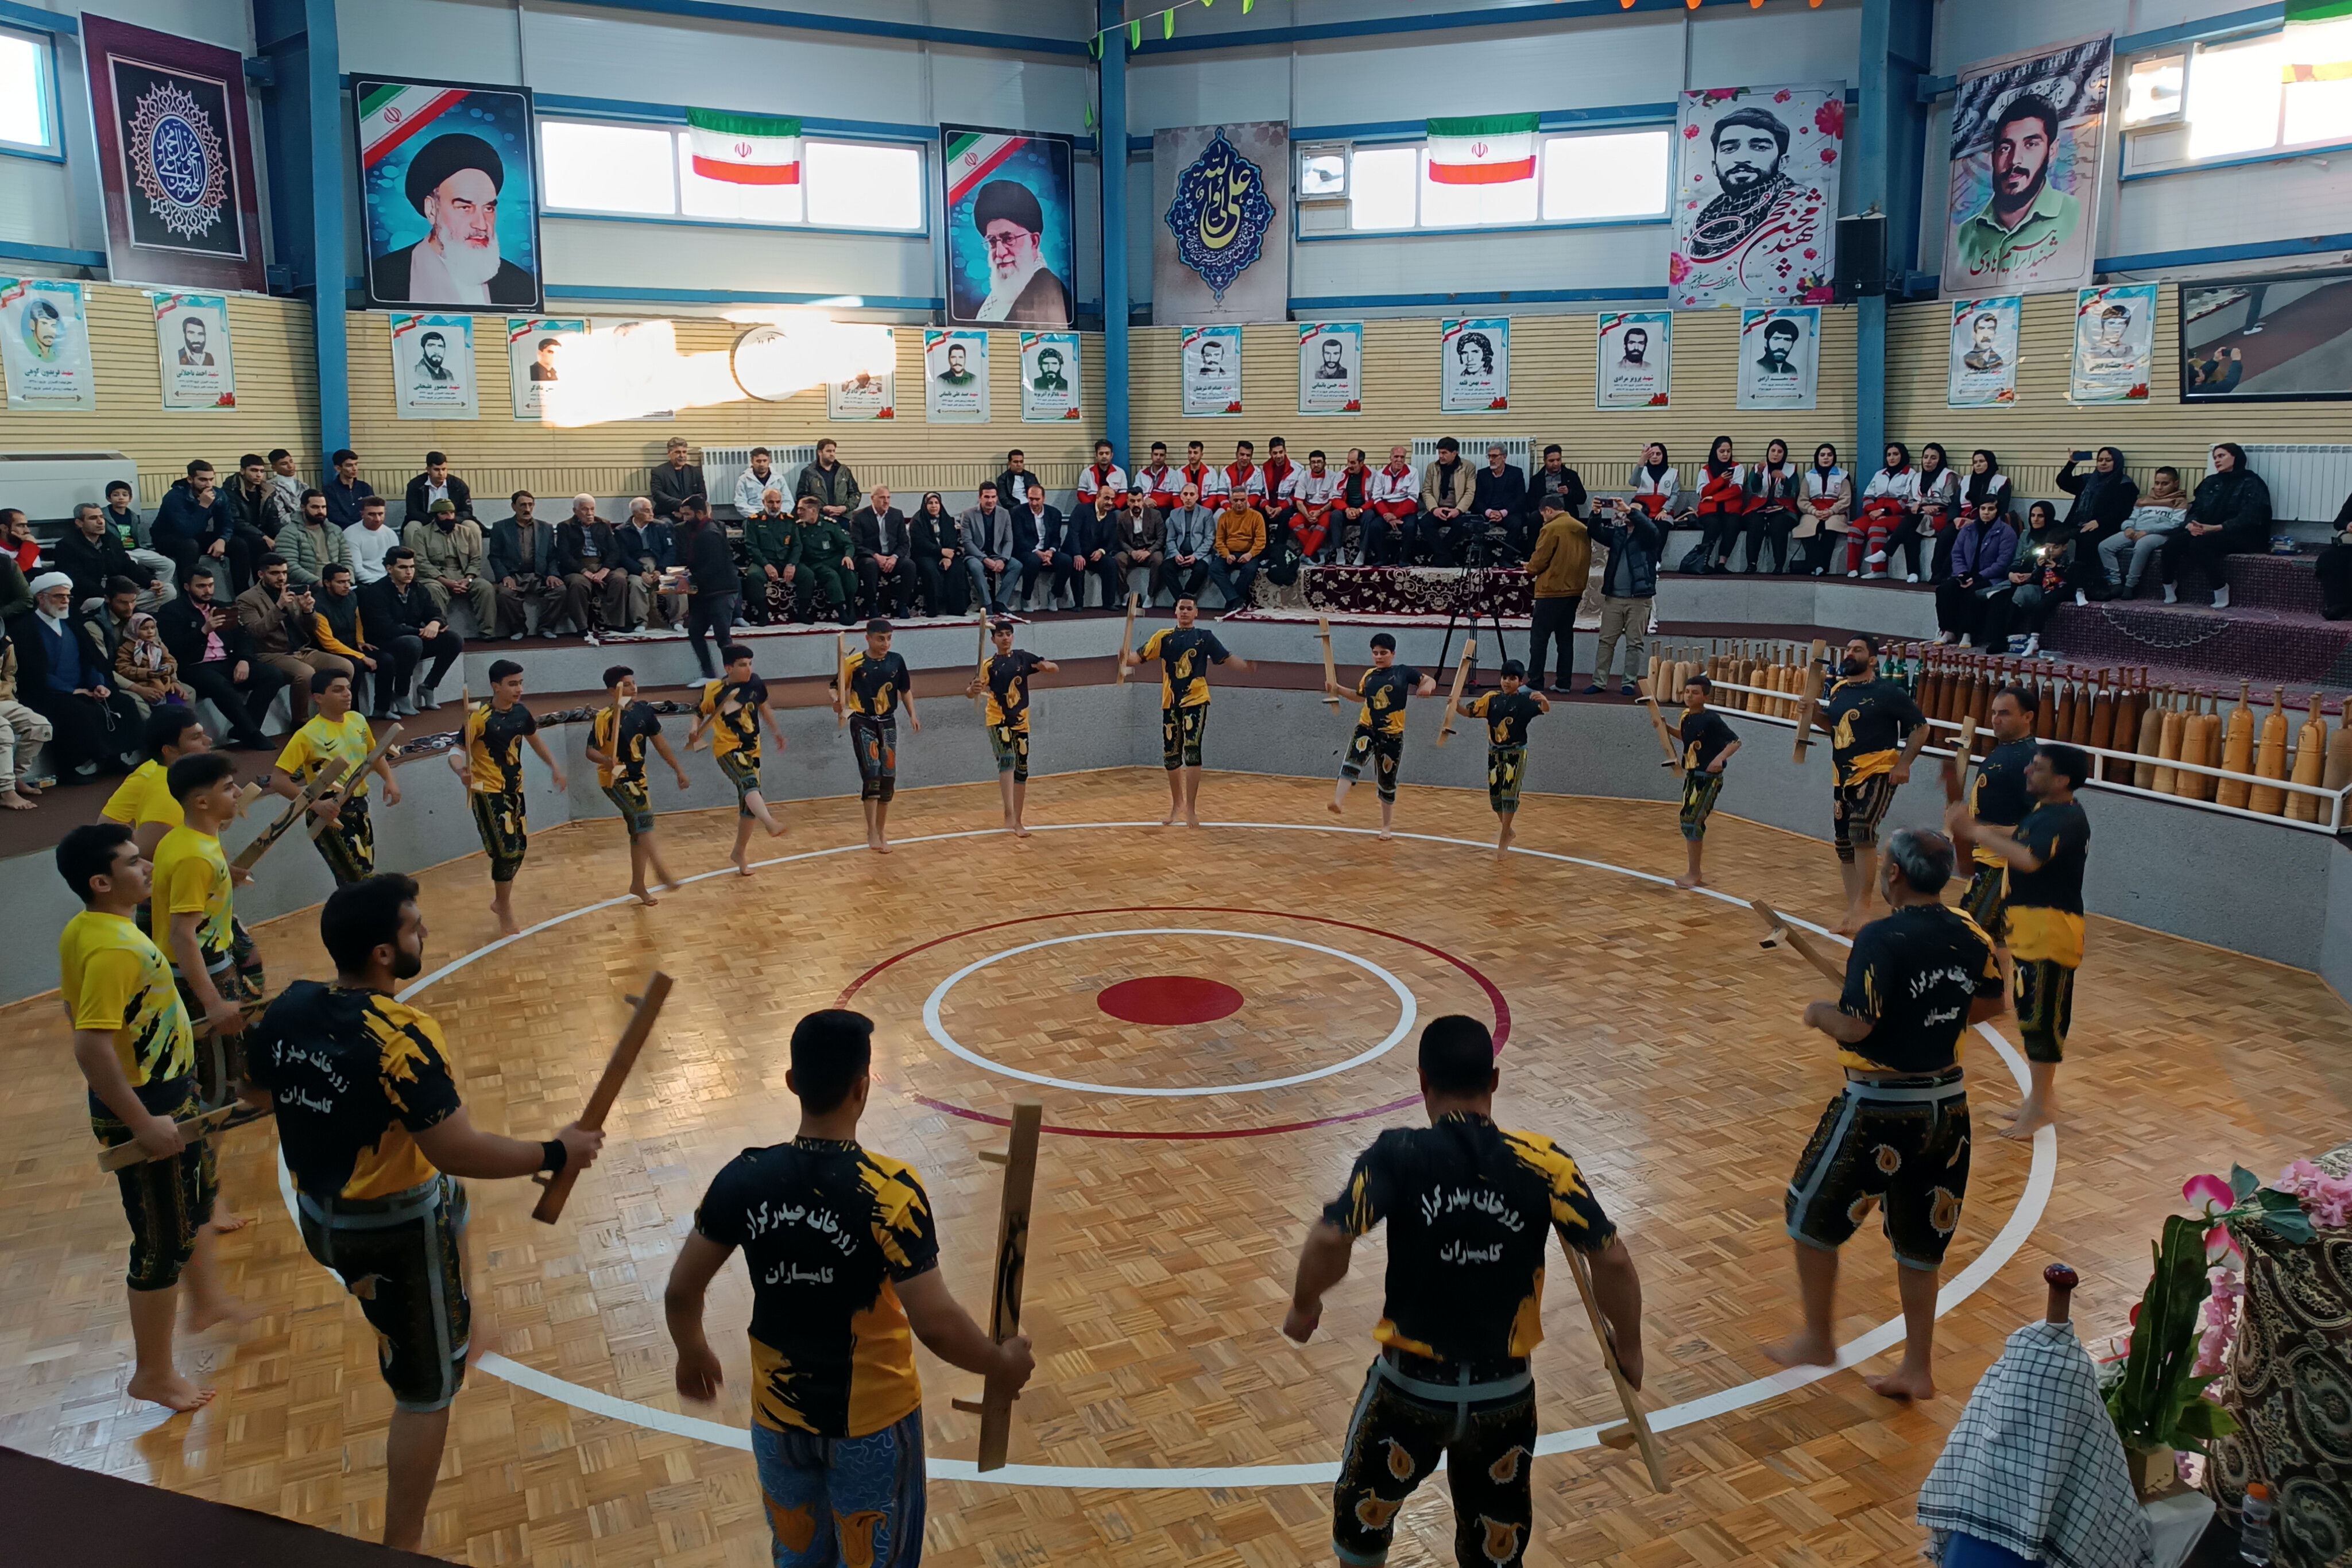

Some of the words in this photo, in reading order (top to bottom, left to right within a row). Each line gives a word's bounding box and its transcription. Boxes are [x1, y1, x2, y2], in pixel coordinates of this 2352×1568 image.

[1970, 249, 1997, 276] هادی
[2027, 235, 2059, 278] شهید
[285, 1044, 308, 1065] حیدر
[279, 1085, 333, 1114] کامیاران
[771, 1202, 807, 1229] حیدر
[1440, 1238, 1504, 1265] کامیاران
[765, 1260, 834, 1286] کامیاران
